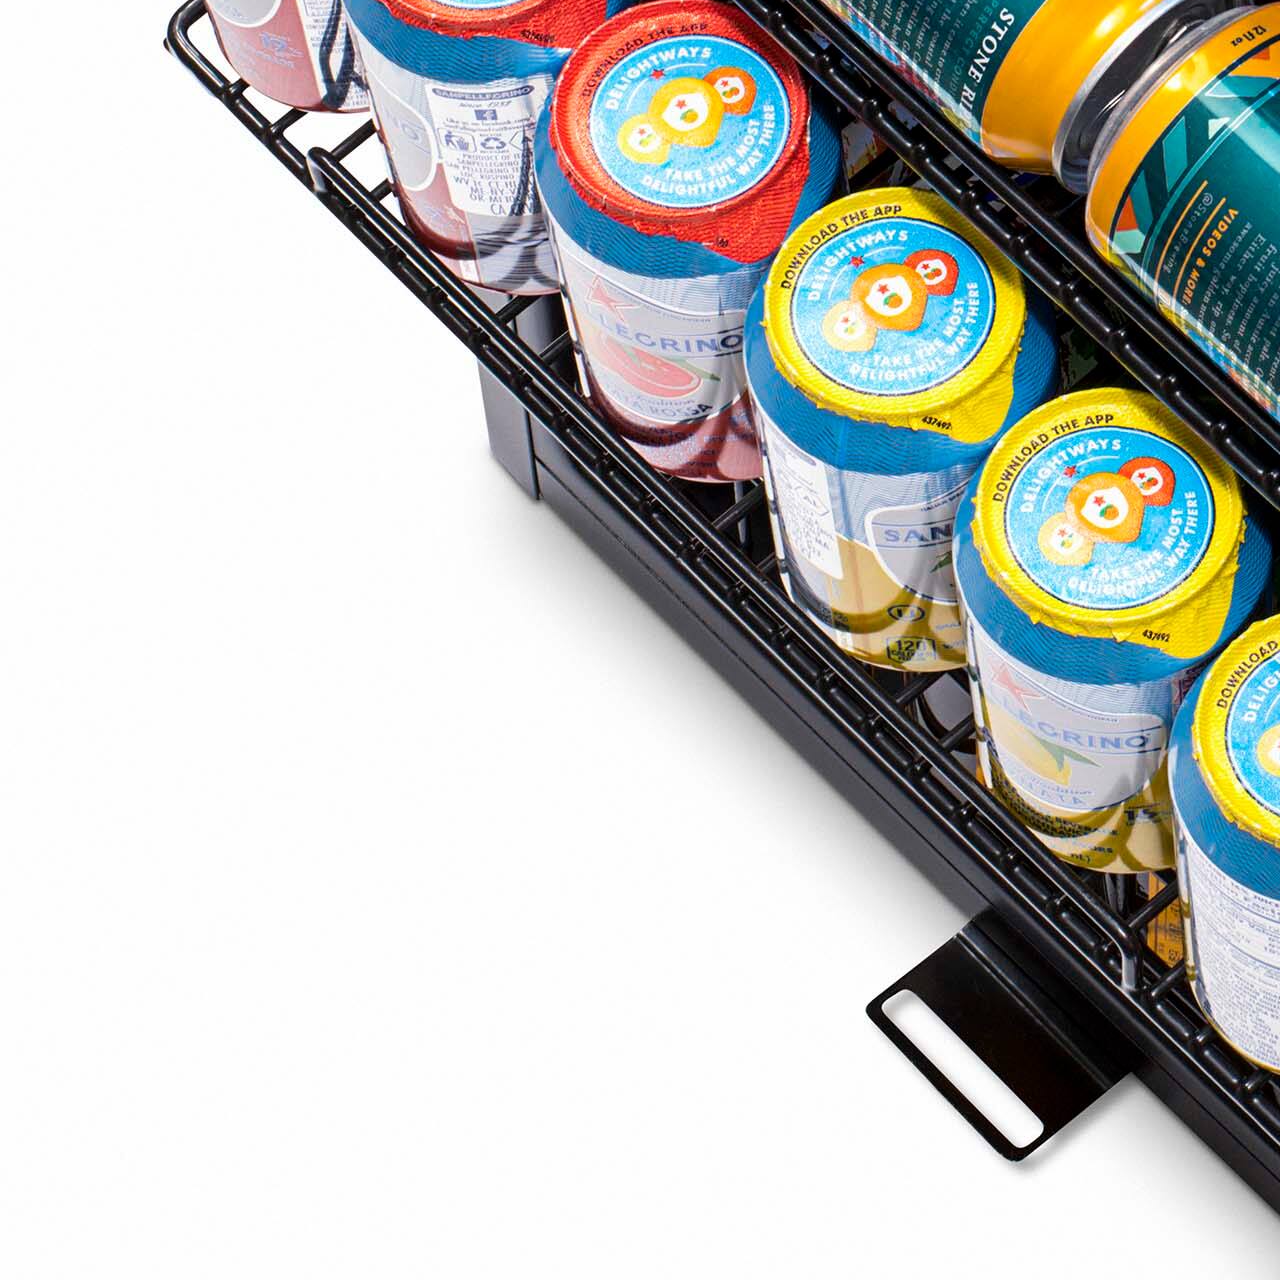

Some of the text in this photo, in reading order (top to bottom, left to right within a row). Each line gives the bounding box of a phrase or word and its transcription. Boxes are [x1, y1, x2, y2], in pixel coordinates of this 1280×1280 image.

[649, 26, 674, 42] THE
[965, 7, 1016, 81] STONE
[605, 47, 713, 111] DELIGHTWAYS
[642, 104, 775, 197] DELIGHTFUL WAY THERE
[664, 119, 760, 182] TAKE THE MOST
[781, 205, 902, 290] DOWNLOAD THE APP
[808, 230, 908, 301] DELIGHTWAYS
[1200, 205, 1239, 256] VIDEOS
[1179, 268, 1202, 305] MORE:
[851, 281, 980, 382] DELIGHTFUL WAY THERE
[873, 297, 964, 367] TAKE THE MOST
[993, 415, 1114, 503] DOWNLOAD THE APP
[1020, 439, 1122, 513] DELIGHTWAYS
[1069, 491, 1198, 597] DELIGHTFUL WAY THERE
[1090, 508, 1184, 579] TAKE THE MOST
[1217, 640, 1278, 709] DOWNLOAD
